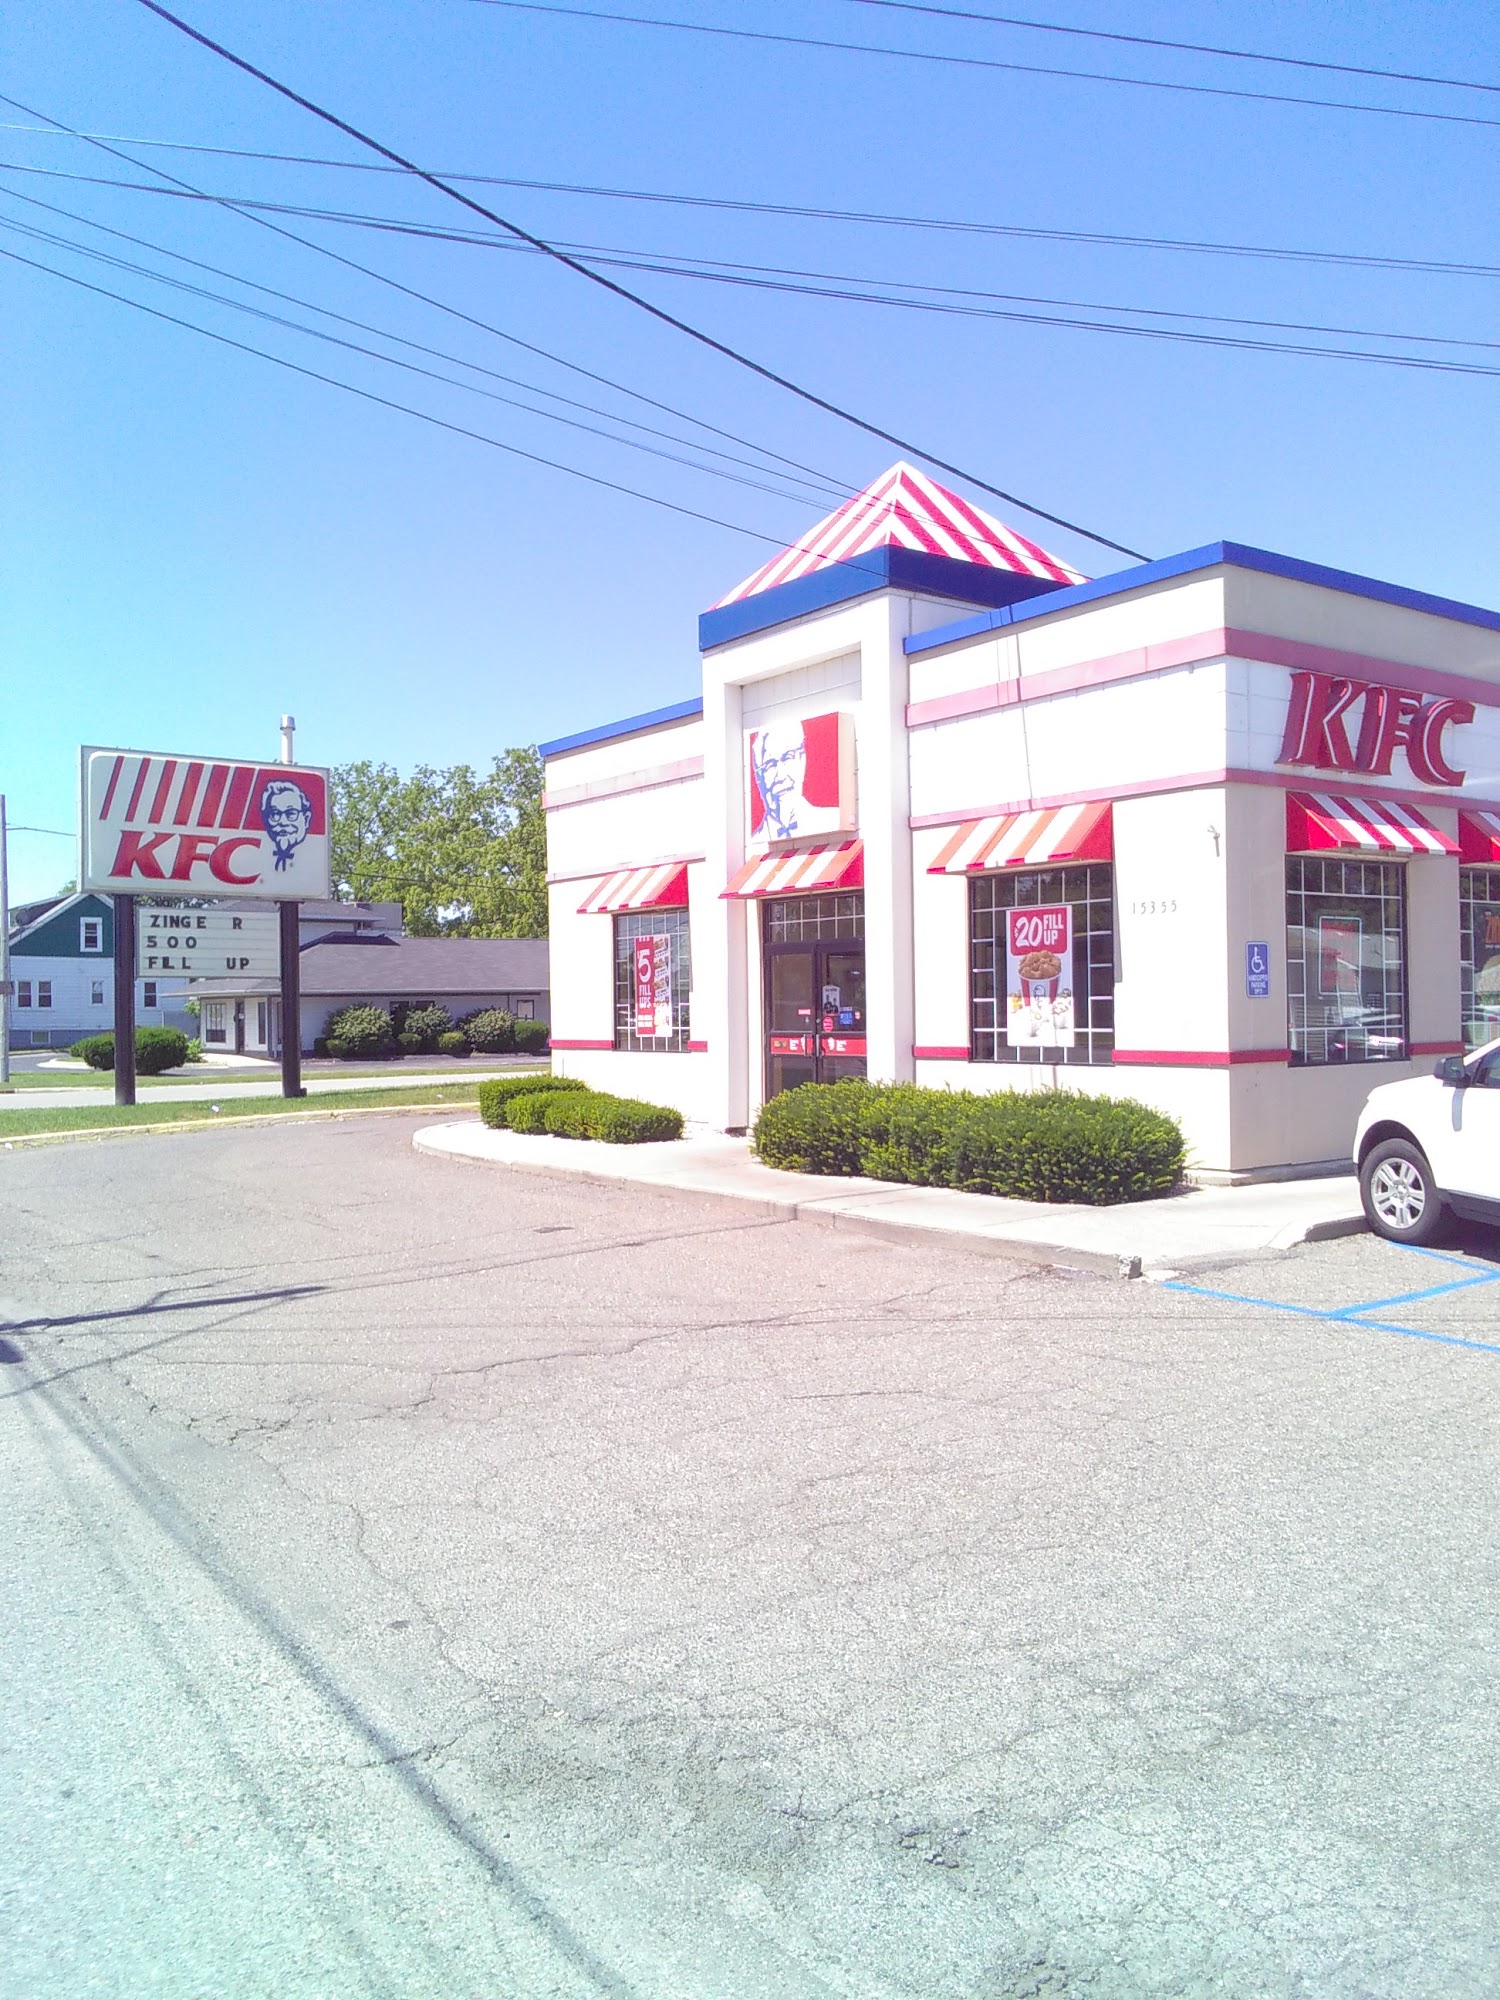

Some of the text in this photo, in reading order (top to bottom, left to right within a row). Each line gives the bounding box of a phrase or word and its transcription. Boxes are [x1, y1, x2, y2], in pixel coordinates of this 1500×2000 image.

[1274, 671, 1477, 788] KFC
[107, 829, 262, 885] KFC
[1132, 899, 1178, 915] 15355
[1043, 913, 1065, 930] FILL
[1043, 929, 1059, 946] UP
[226, 957, 250, 970] UP
[638, 984, 652, 997] FILL
